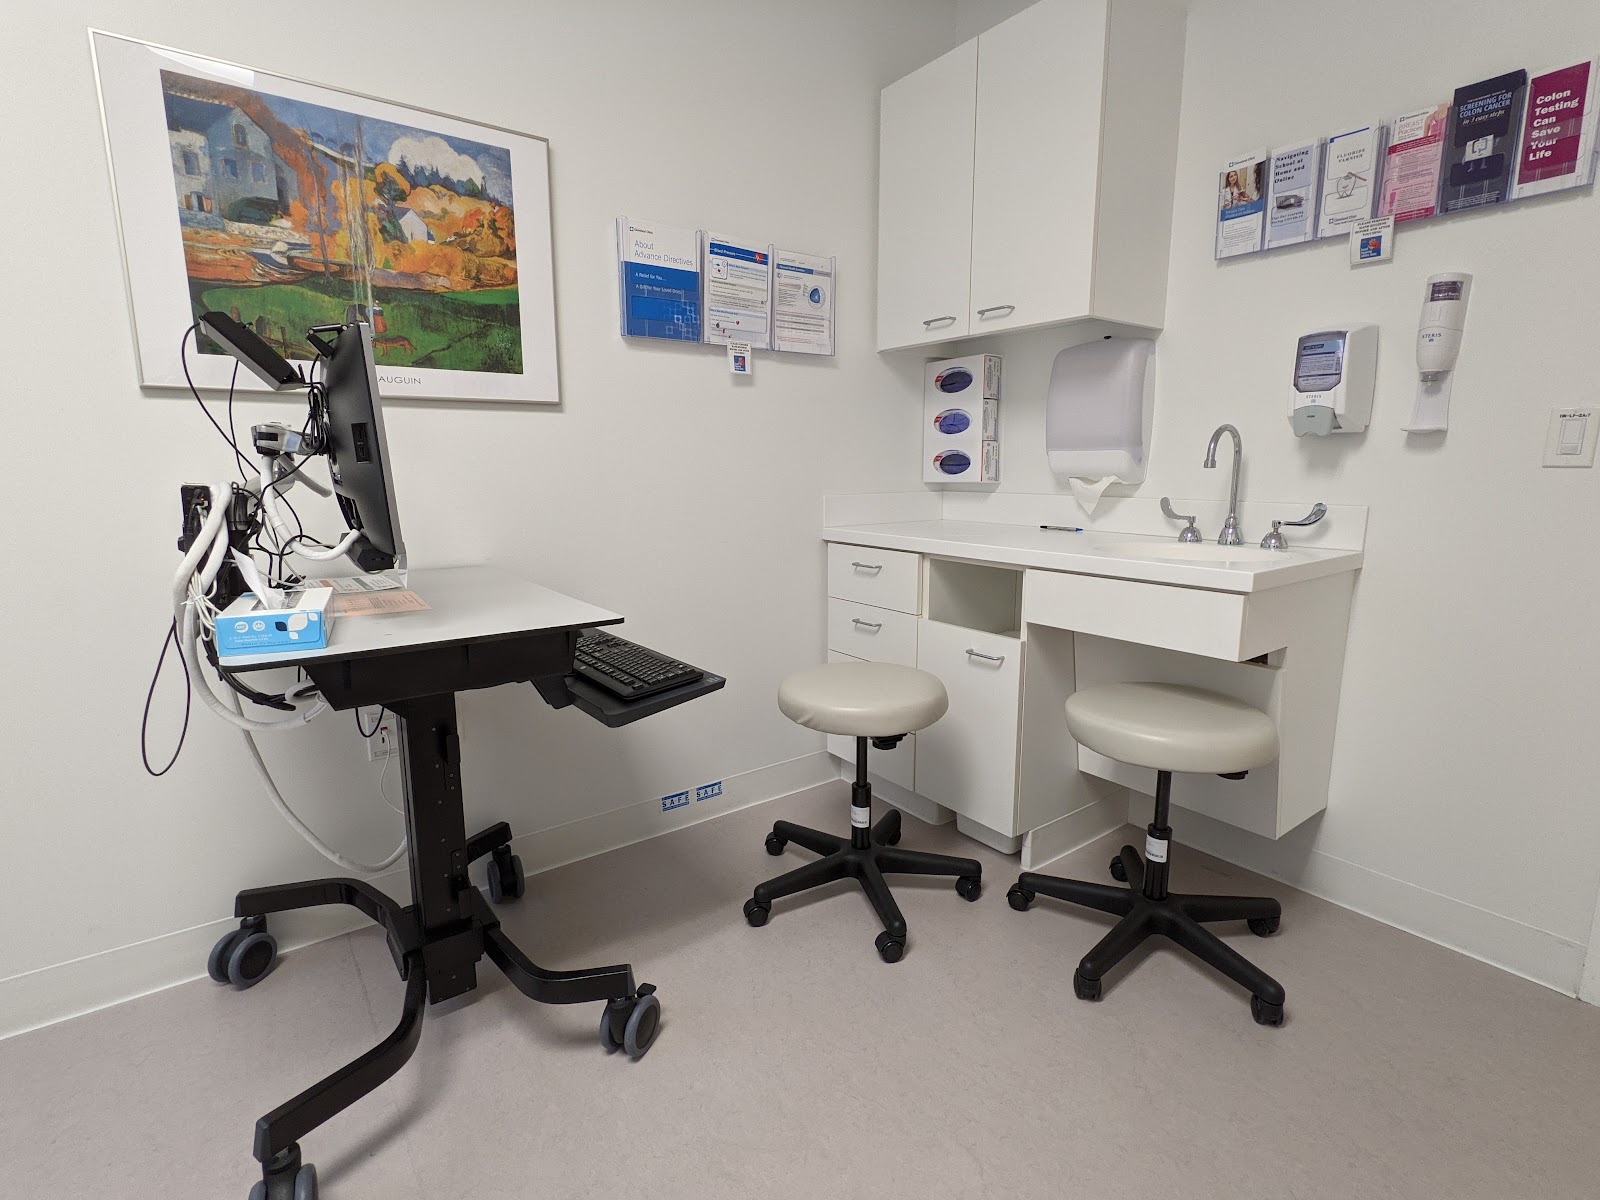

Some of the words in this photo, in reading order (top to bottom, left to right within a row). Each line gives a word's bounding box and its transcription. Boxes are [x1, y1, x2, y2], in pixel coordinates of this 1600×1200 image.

[1459, 96, 1497, 112] SCREENING
[1498, 91, 1513, 101] FOR
[1536, 89, 1571, 105] Colon
[1459, 108, 1483, 119] COLON
[1484, 100, 1511, 112] CANCER
[1534, 97, 1580, 117] Testing
[1475, 114, 1489, 122] easy
[1489, 109, 1506, 118] steps
[1533, 116, 1556, 127] Can
[1531, 126, 1561, 139] Save
[1530, 137, 1557, 150] Your
[1276, 150, 1309, 161] Navigating
[1337, 148, 1366, 159] FLUORIDE
[1338, 154, 1364, 163] VARNISH
[1528, 150, 1552, 161] Life
[1275, 159, 1296, 169] School
[1275, 169, 1291, 177] Home
[1274, 175, 1294, 184] Online
[634, 239, 654, 250] About
[634, 249, 662, 261] Advance
[663, 254, 694, 267] Directives
[378, 375, 422, 385] AUGUIN
[696, 784, 723, 798] SAFE
[661, 794, 690, 808] SAFE
